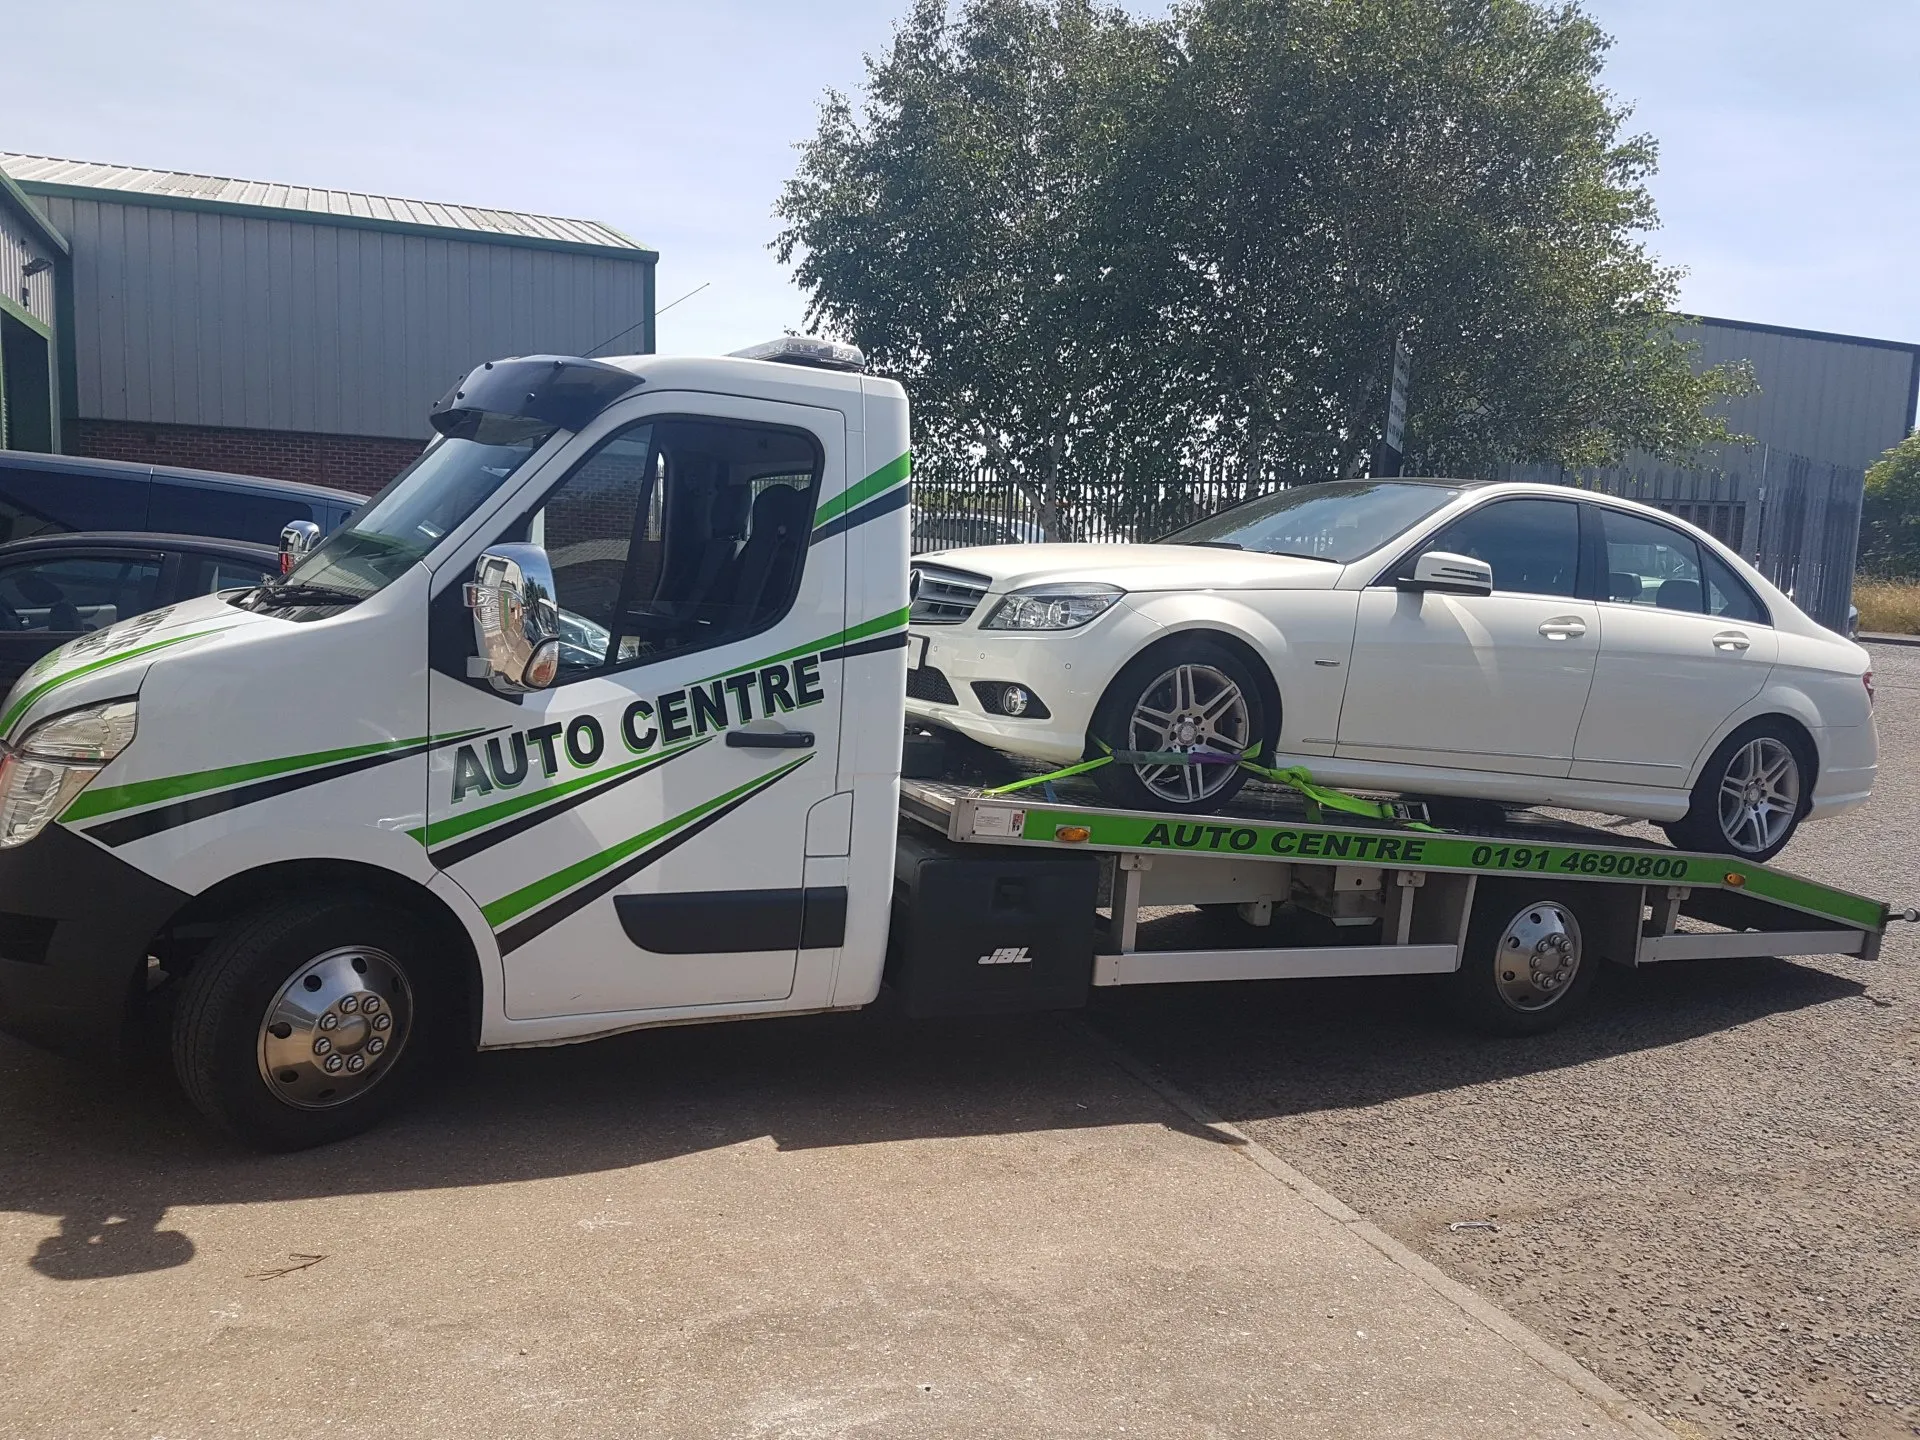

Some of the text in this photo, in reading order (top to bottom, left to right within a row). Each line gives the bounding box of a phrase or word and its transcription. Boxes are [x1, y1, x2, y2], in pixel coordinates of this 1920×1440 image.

[451, 657, 825, 804] AUTO CENTRE
[1141, 823, 1688, 878] AUTO CENTRE 0191 4690800
[977, 947, 1032, 965] JBL
